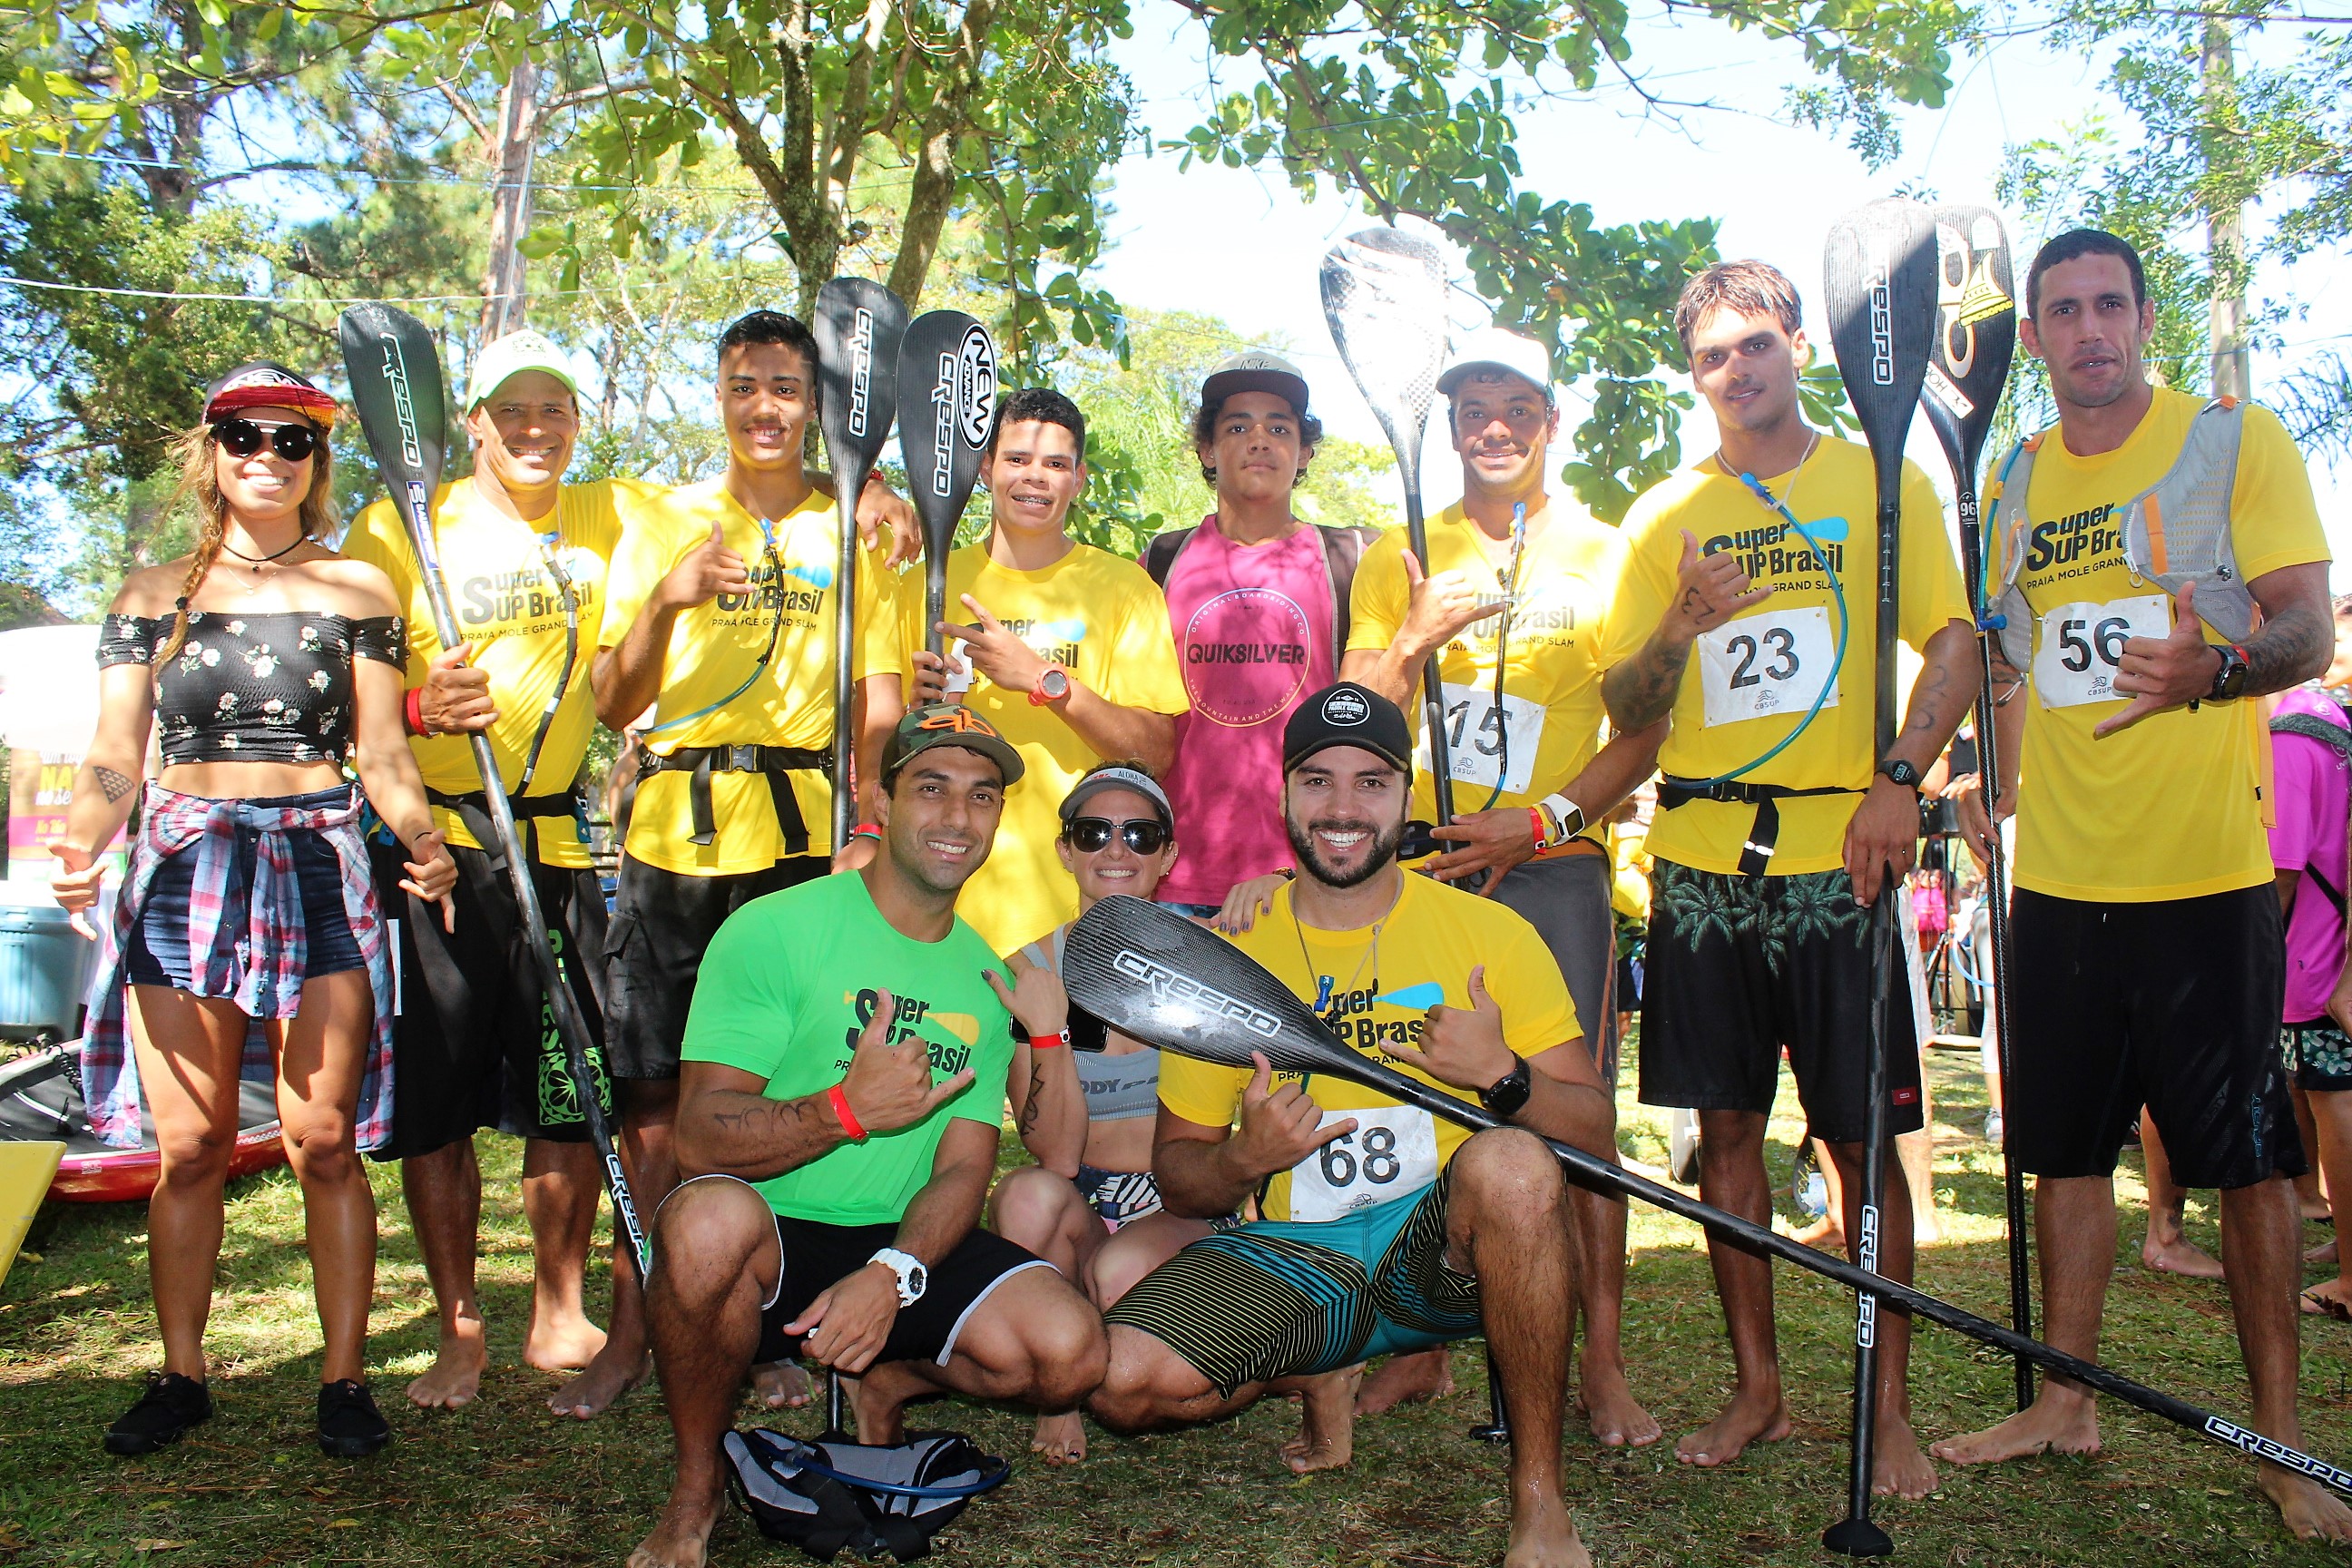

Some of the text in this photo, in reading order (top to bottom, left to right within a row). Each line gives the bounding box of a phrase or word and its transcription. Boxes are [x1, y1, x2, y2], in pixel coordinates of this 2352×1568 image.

[1863, 263, 1894, 386] RESPO
[848, 307, 874, 436] CRESPO
[964, 360, 972, 414] ADVANCE
[971, 339, 992, 435] NEW
[931, 351, 956, 497] CRESPO
[1960, 502, 1976, 516] 96
[1769, 544, 1843, 575] Brasil
[1773, 581, 1811, 592] GRAND
[2026, 574, 2054, 590] PRAIA
[2058, 566, 2090, 581] MOLE
[762, 617, 793, 626] GRND
[1191, 593, 1305, 635] ORIGINAL BOARDRIDING CO
[460, 632, 495, 641] PRAIA
[499, 627, 528, 637] MOLE
[532, 620, 568, 633] GRAND
[1445, 642, 1471, 652] RAIA
[1475, 645, 1498, 653] MOL
[1547, 638, 1574, 648] SLAM
[2060, 617, 2131, 672] 56
[1187, 643, 1305, 664] QUIKSILVER
[1726, 627, 1799, 690] 23
[1754, 699, 1779, 710] CBSUP
[2088, 686, 2112, 696] CBSUP
[1196, 697, 1238, 721] MOUNTAIN
[1241, 713, 1260, 721] AND
[1262, 705, 1279, 716] THE
[1448, 701, 1513, 756] 15
[1118, 770, 1139, 781] ALOHA
[1453, 764, 1476, 776] CBSUP
[1113, 950, 1282, 1038] CRESPO
[1357, 1017, 1426, 1049] Bras
[1080, 1077, 1122, 1095] ODY
[1320, 1126, 1400, 1187] 68
[1857, 1204, 1878, 1348] CREPO
[2205, 1416, 2352, 1493] CRESPO
